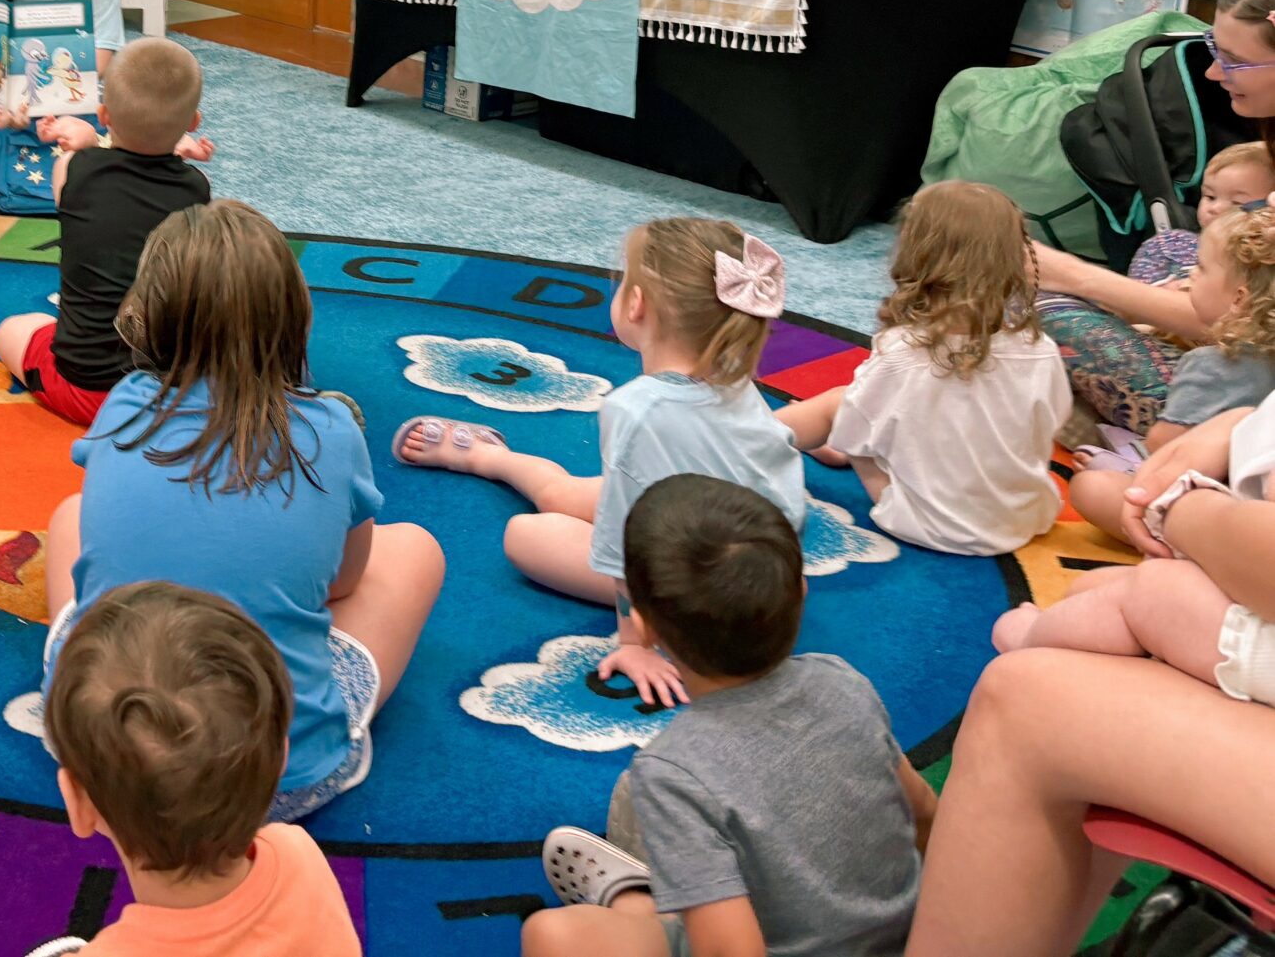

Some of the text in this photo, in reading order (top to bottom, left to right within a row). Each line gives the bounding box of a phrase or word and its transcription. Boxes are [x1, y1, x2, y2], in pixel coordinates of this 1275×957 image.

[342, 255, 421, 286] C
[512, 275, 606, 311] D
[469, 361, 533, 387] 3
